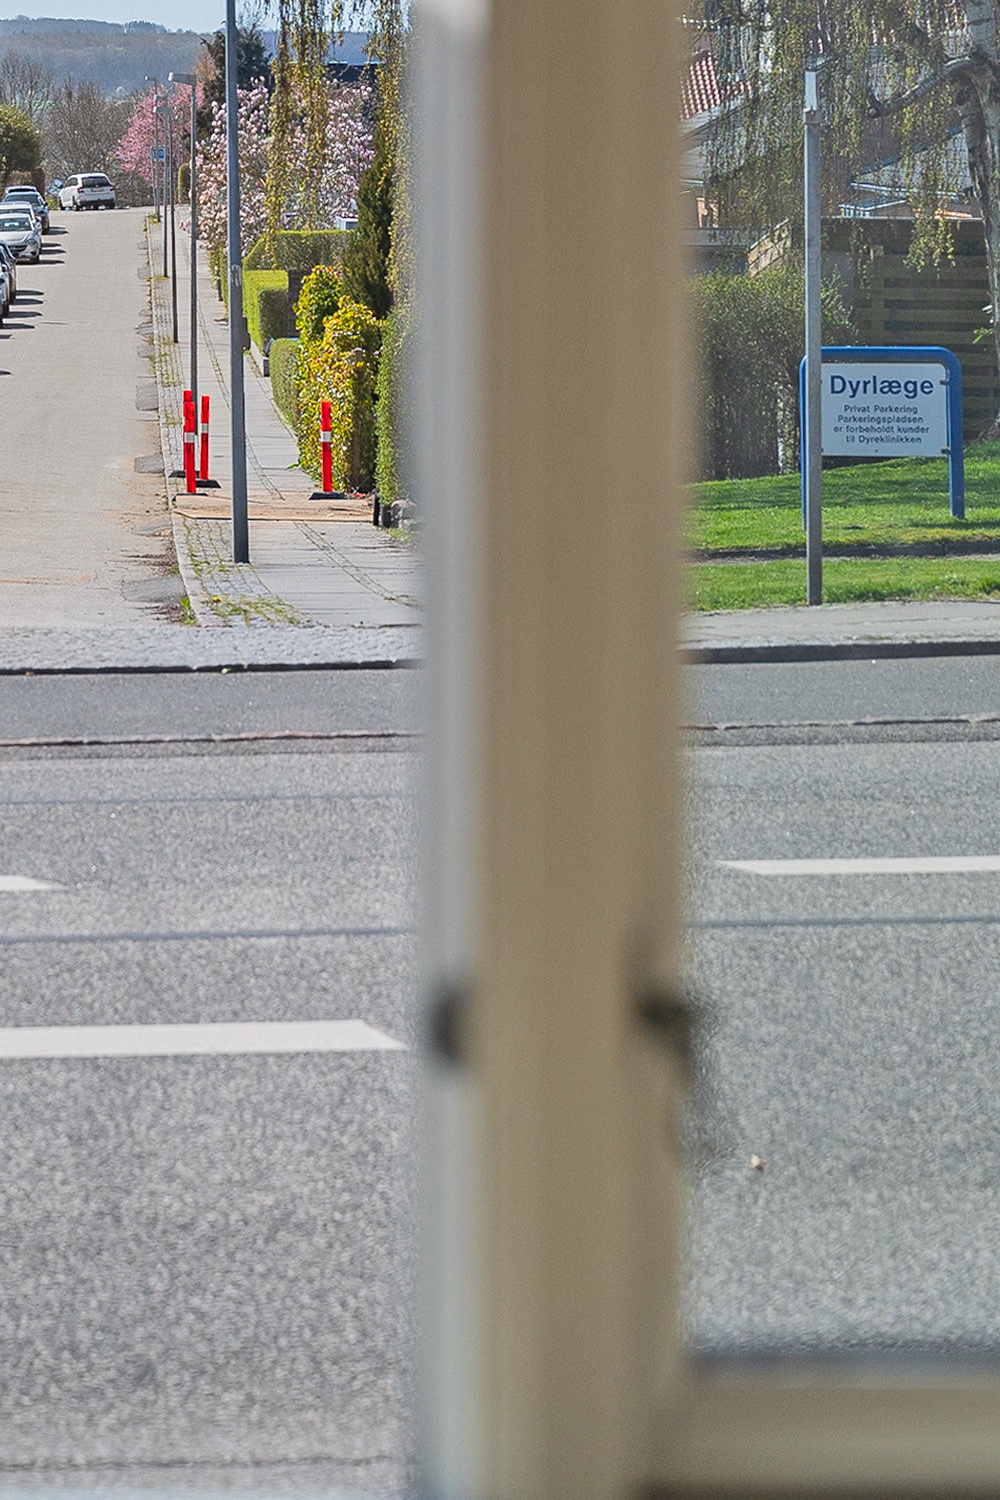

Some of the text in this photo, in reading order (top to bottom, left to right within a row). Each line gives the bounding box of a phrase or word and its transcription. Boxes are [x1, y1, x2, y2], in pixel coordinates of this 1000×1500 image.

[830, 375, 934, 399] Dyrlæge
[844, 404, 918, 414] Privat Parkering
[838, 415, 924, 424] Parkeringspladsen
[846, 425, 895, 433] forbeholdt
[897, 425, 930, 433] kunder
[846, 435, 922, 444] til Dyreklinikken
